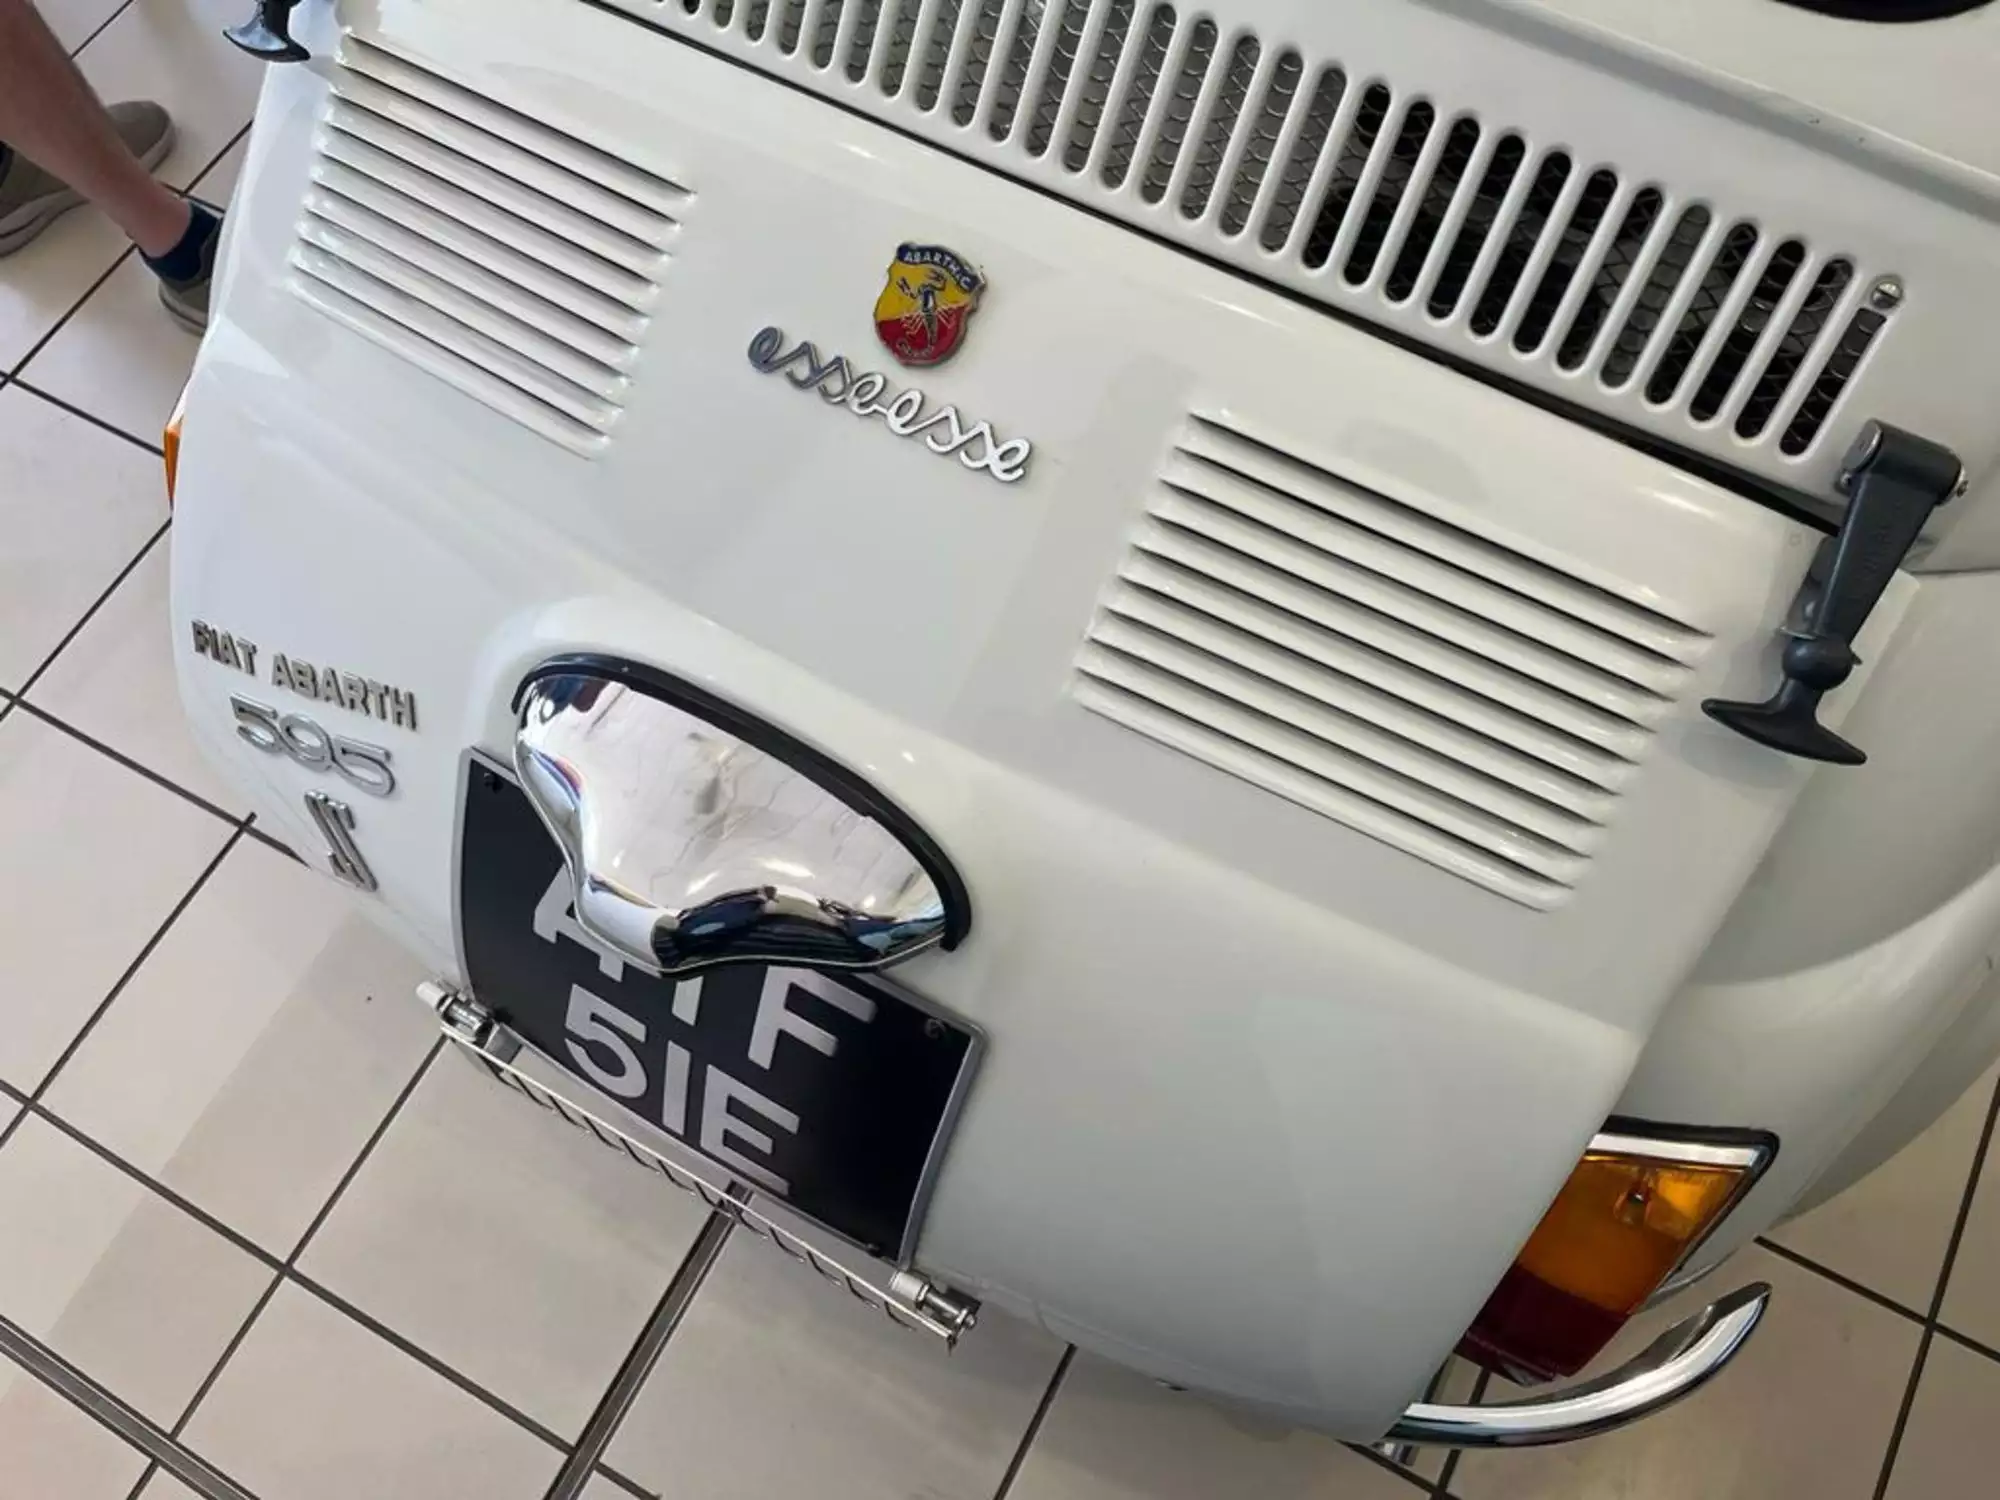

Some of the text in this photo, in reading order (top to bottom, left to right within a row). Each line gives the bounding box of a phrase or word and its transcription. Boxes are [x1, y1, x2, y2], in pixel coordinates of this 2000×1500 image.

[192, 619, 417, 731] FIAT ABARTH
[229, 691, 396, 798] 595
